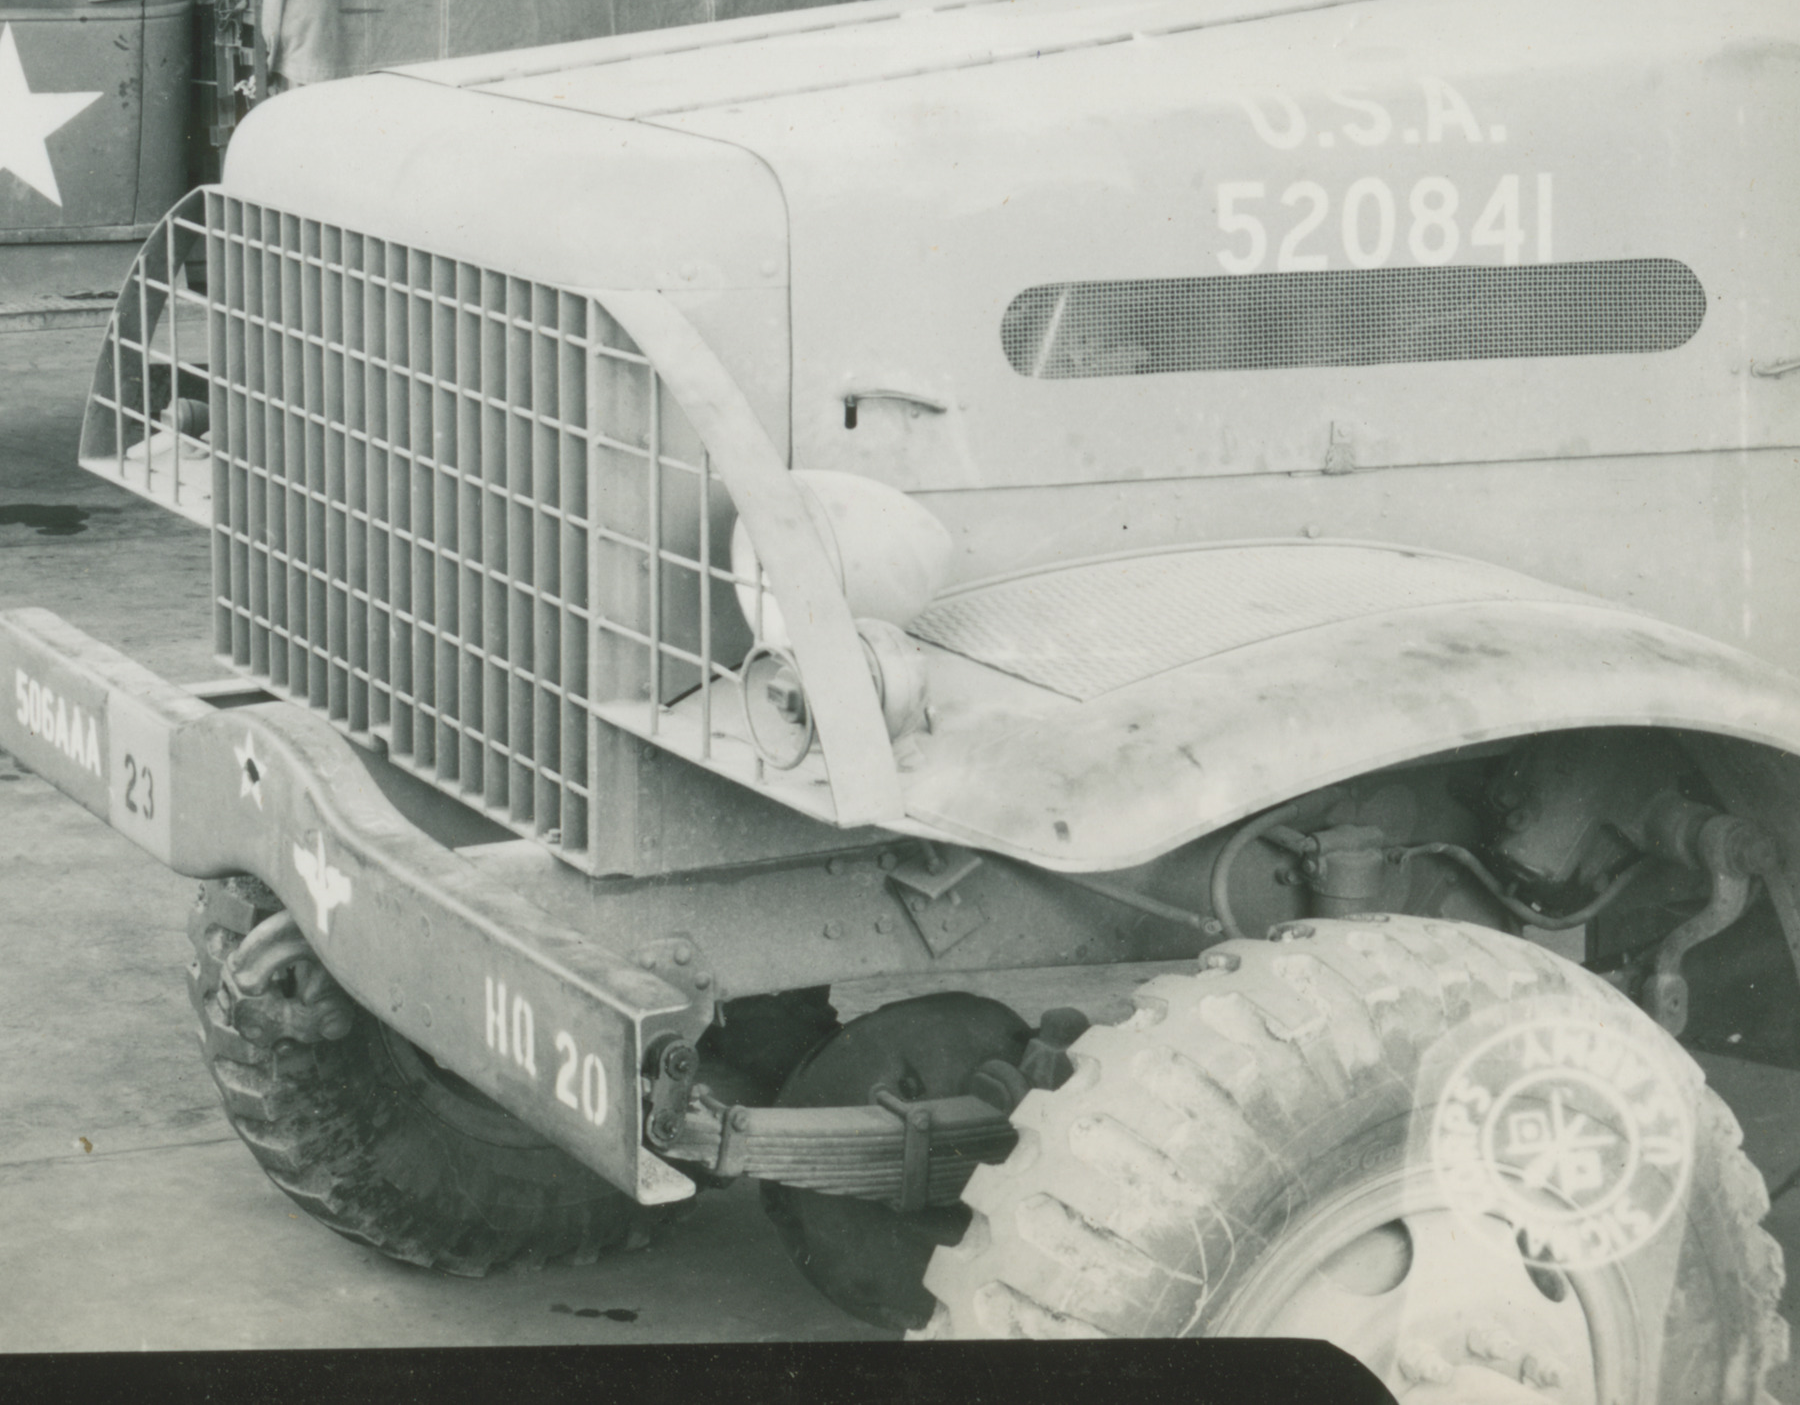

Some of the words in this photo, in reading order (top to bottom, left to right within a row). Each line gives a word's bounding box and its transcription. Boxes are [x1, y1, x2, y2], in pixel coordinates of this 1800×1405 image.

[1240, 74, 1508, 150] U.S.A.
[1215, 172, 1554, 275] 520841
[15, 667, 102, 778] 506AAA
[124, 753, 155, 820] 23
[484, 975, 538, 1078] HQ
[554, 1029, 608, 1127] 20
